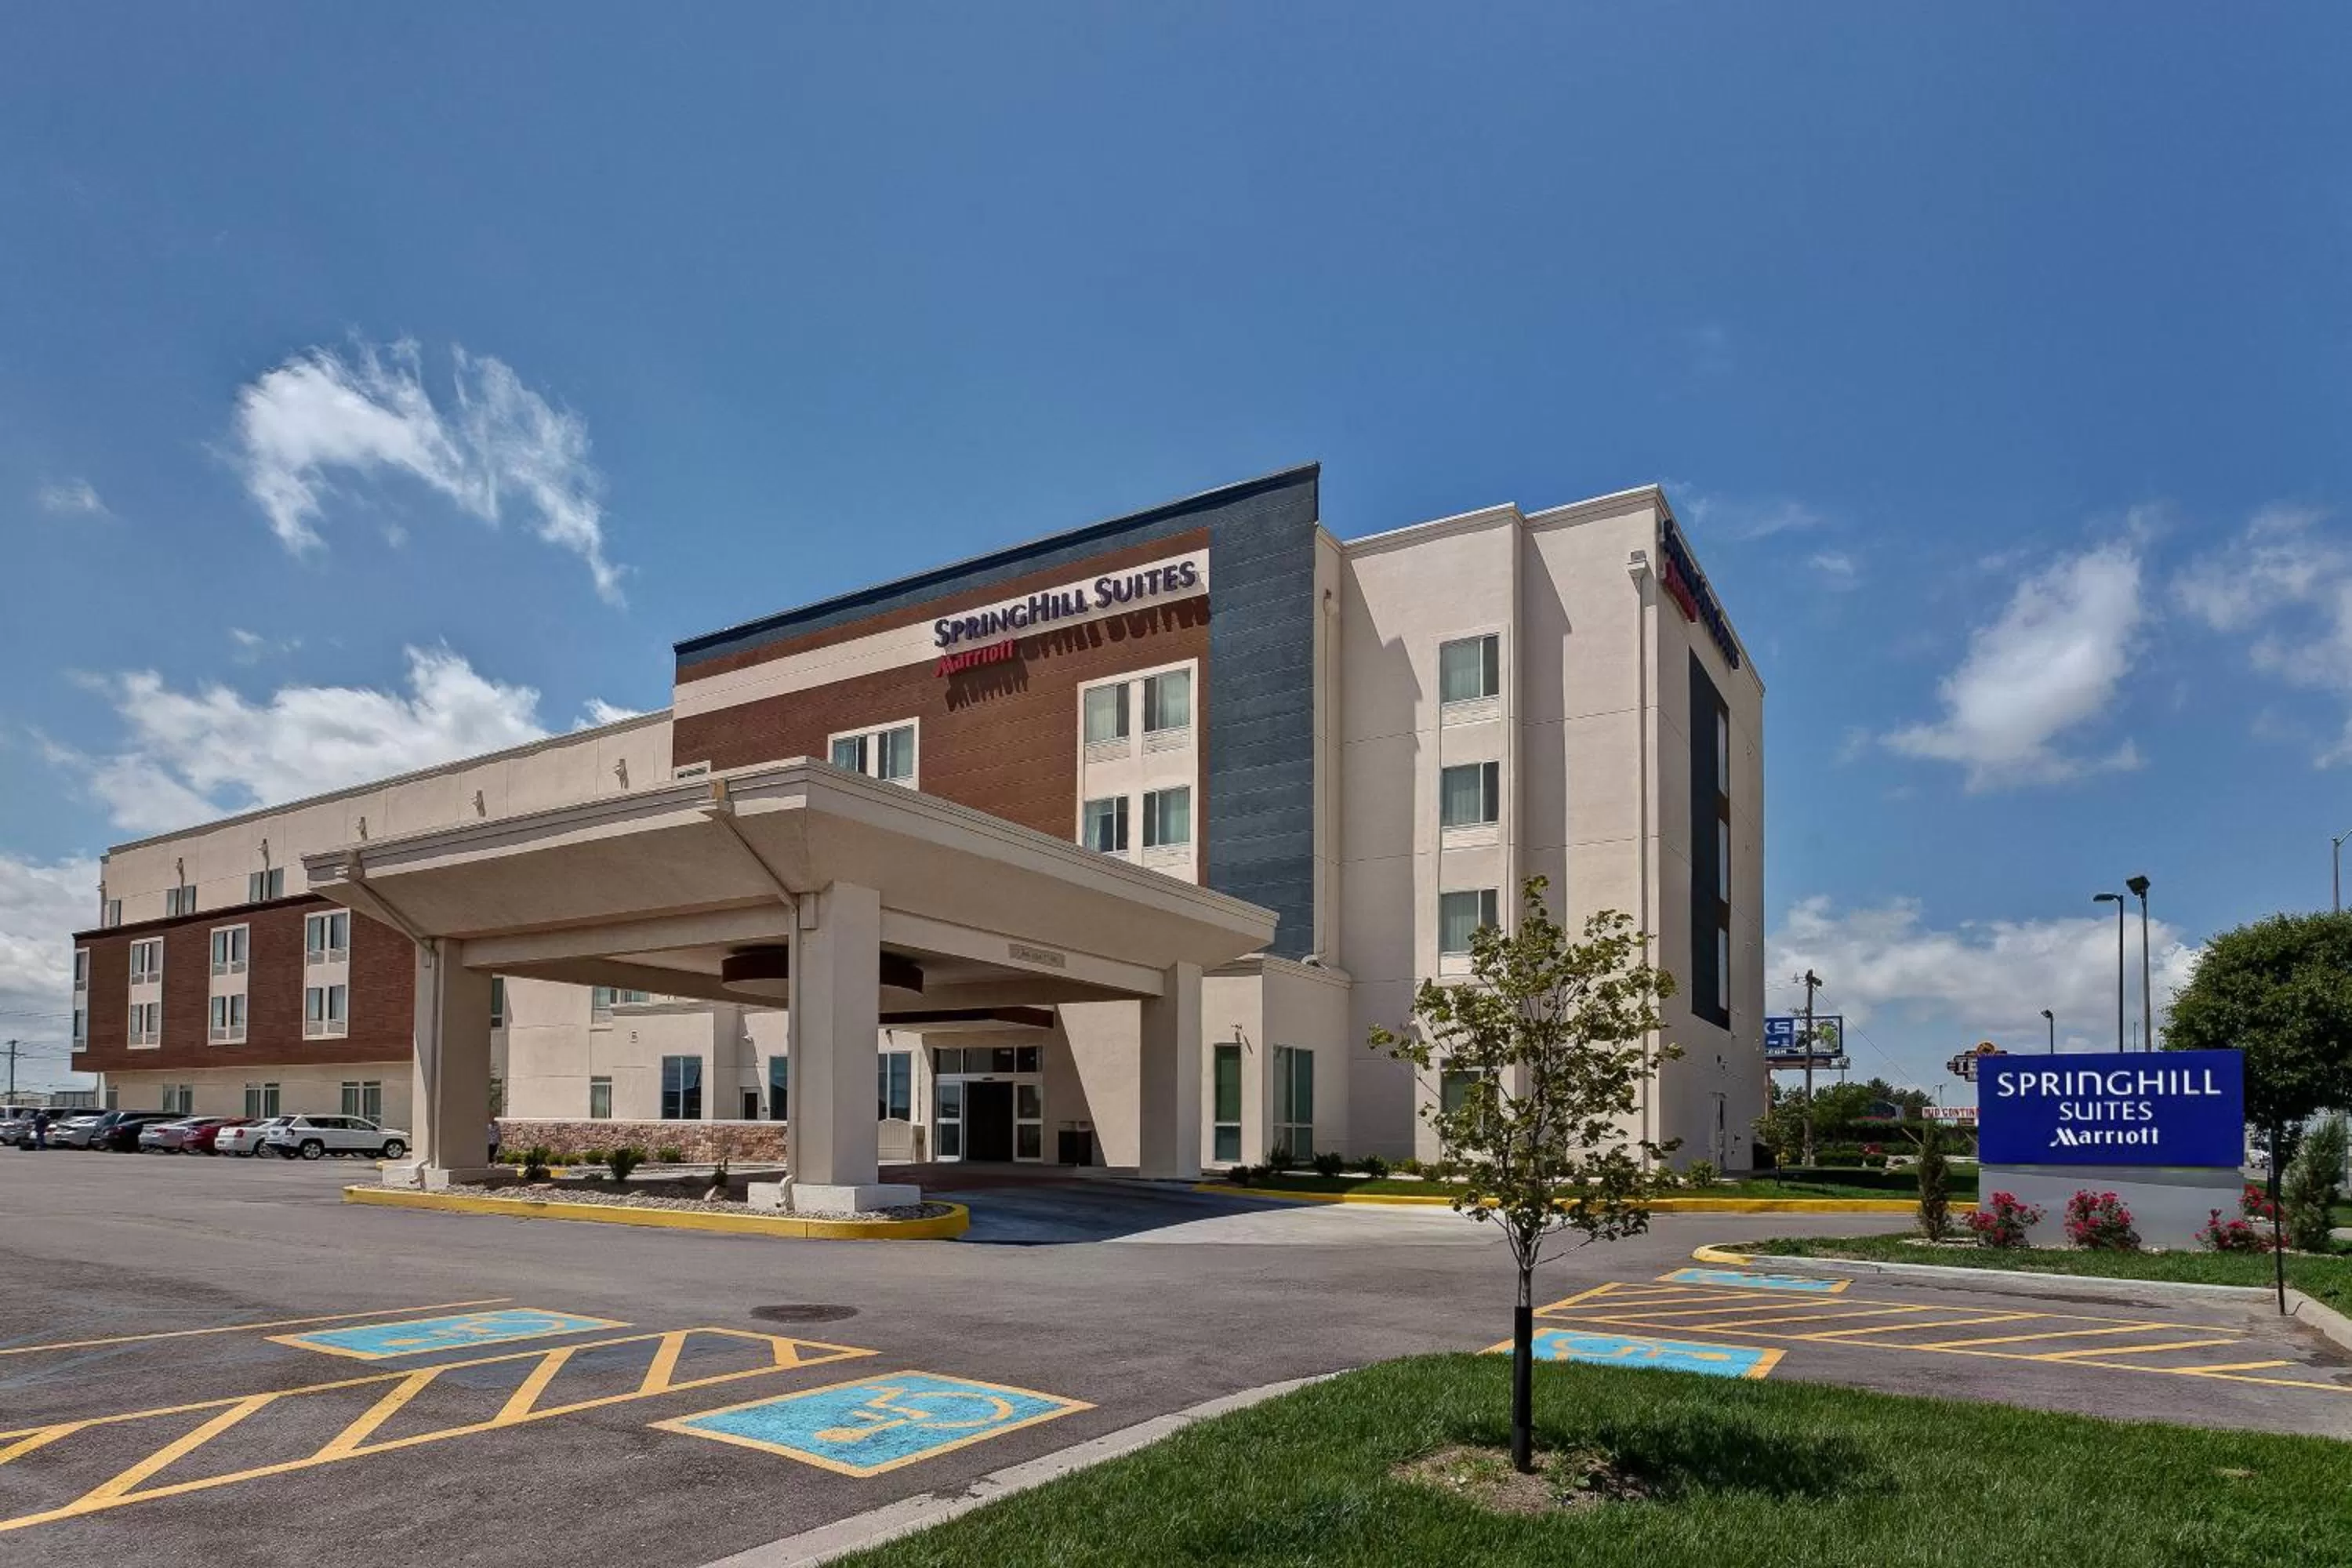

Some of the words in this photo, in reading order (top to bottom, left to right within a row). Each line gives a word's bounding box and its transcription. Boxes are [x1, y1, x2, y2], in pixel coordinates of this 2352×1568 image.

[934, 589, 1090, 648] SPRINGHILL
[1094, 560, 1198, 609] SUITES
[934, 638, 1017, 678] Marriott
[1997, 1069, 2222, 1098] SPRINGHILL
[2059, 1100, 2153, 1121] SUITES
[2049, 1127, 2159, 1148] Marriott
